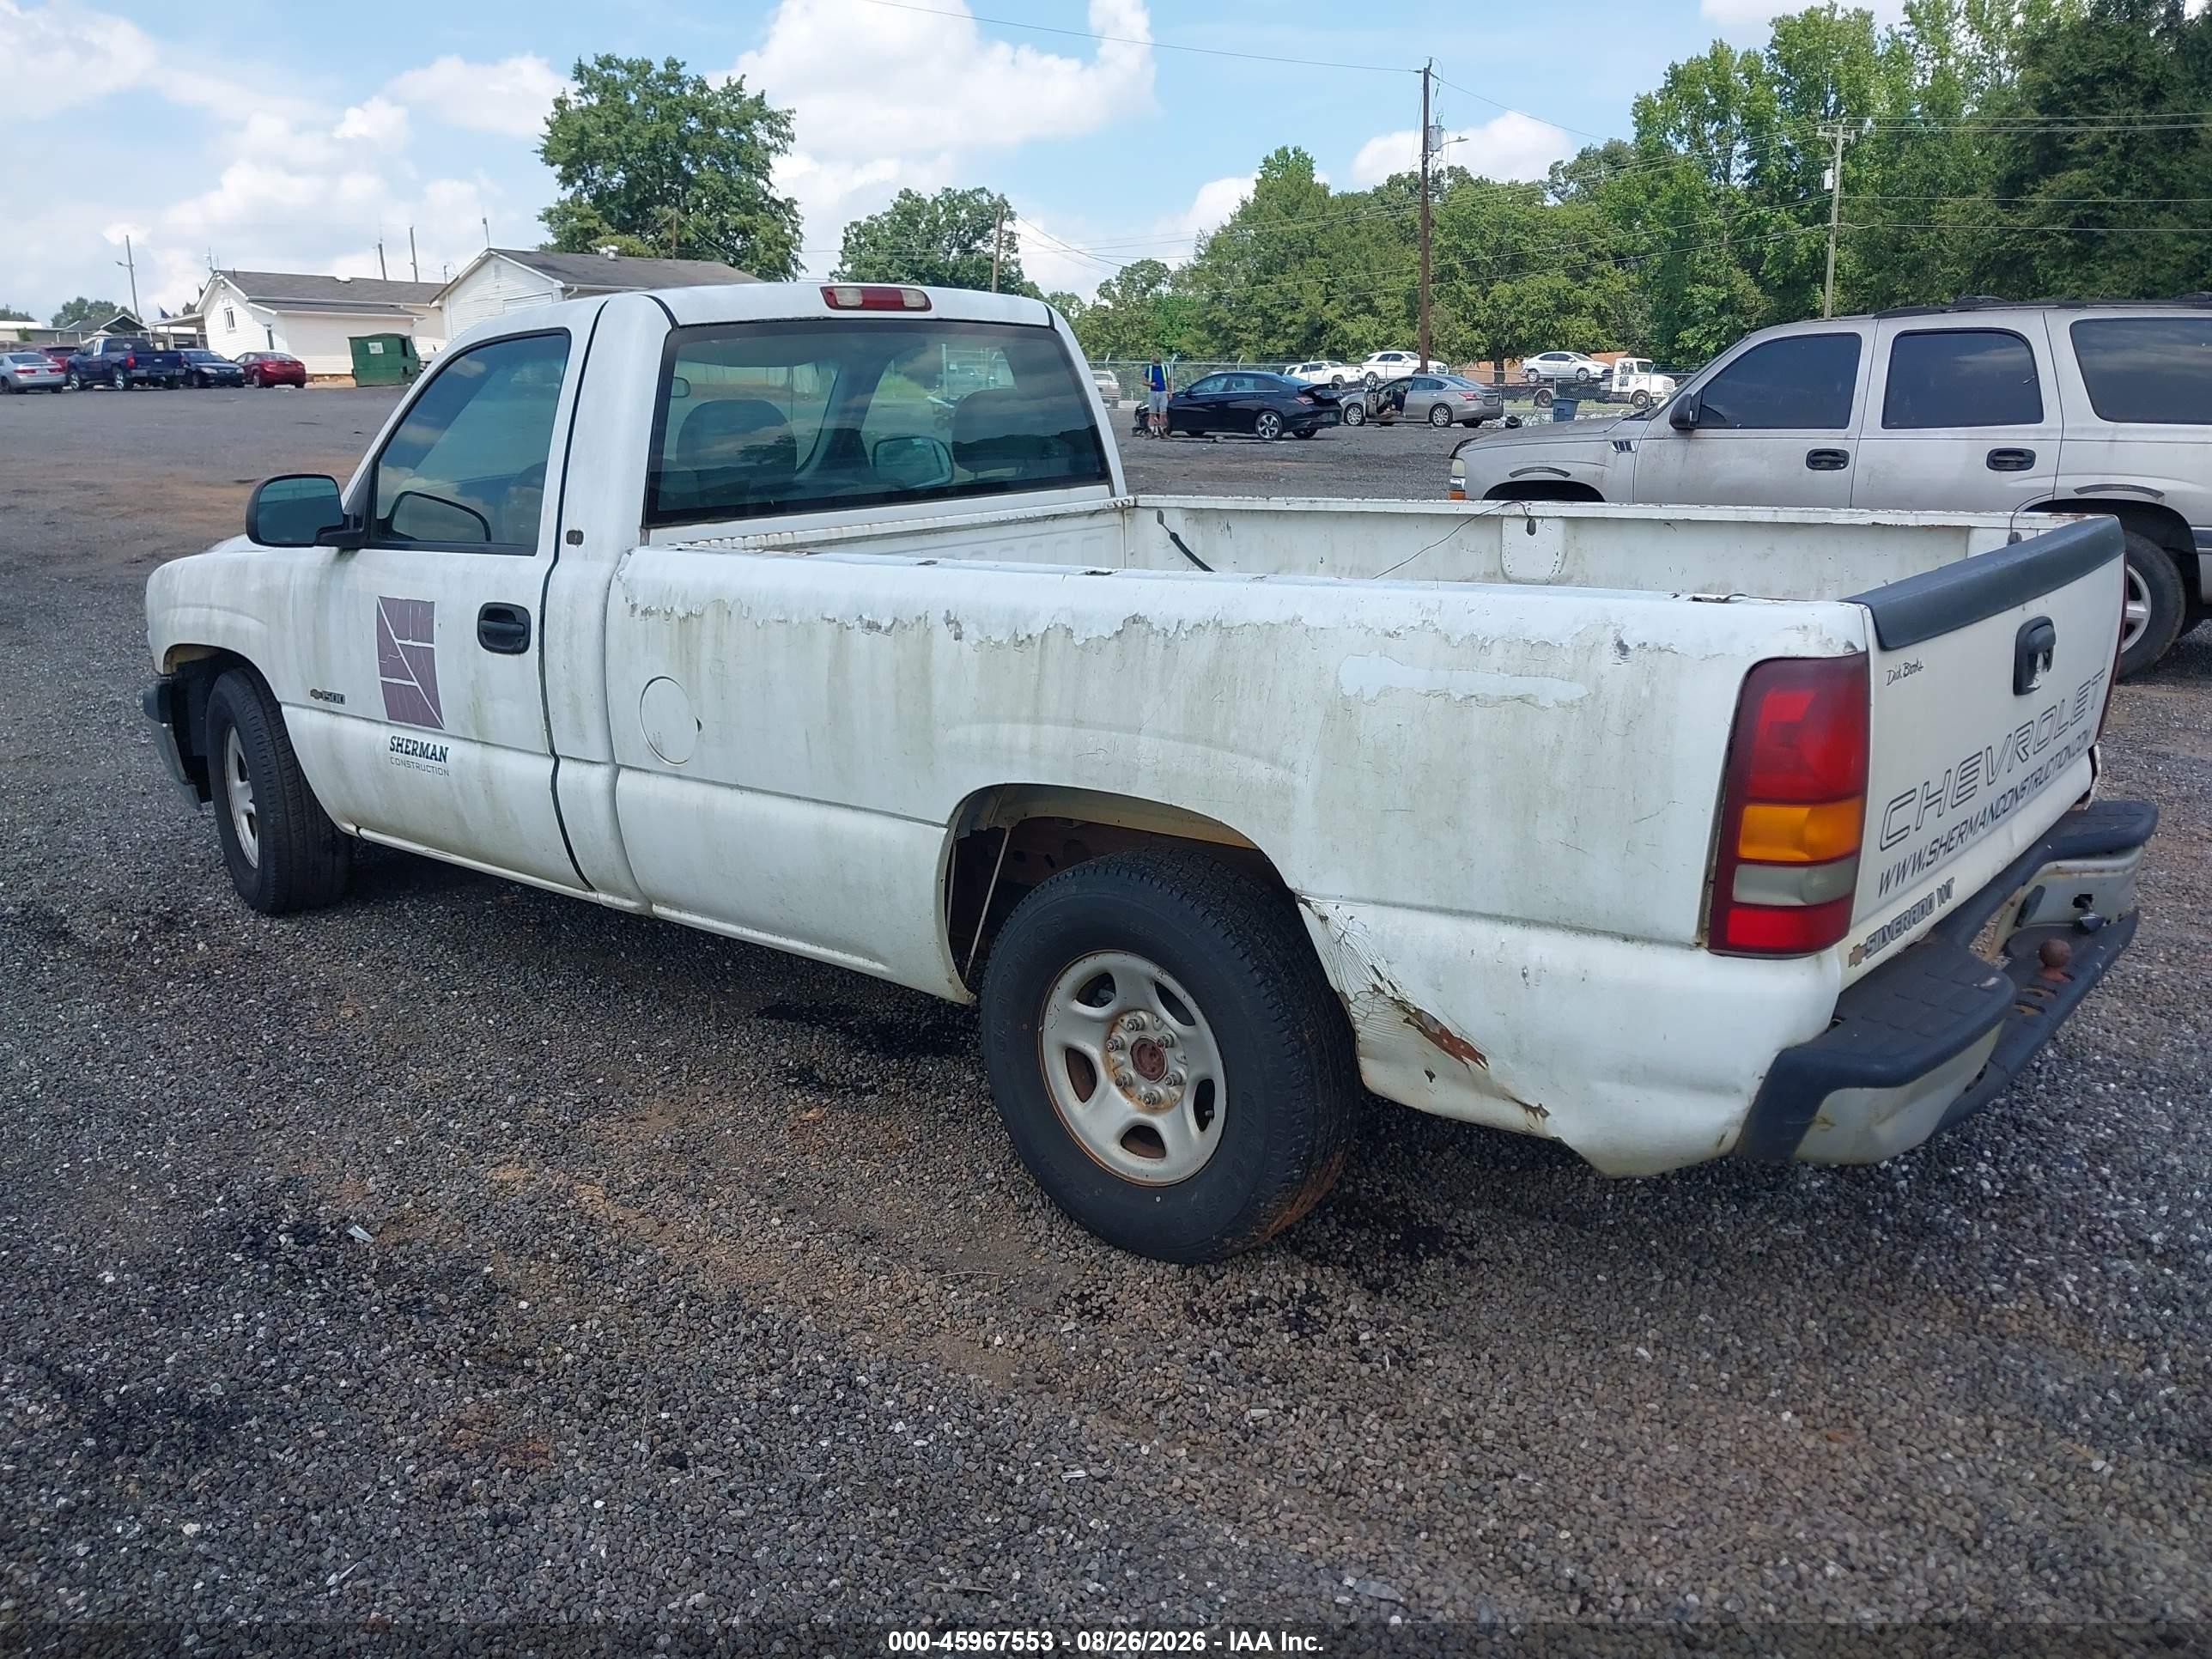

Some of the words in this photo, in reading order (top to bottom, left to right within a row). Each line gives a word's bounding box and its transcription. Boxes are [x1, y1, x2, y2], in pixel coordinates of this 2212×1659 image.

[322, 690, 346, 705] 1500
[389, 735, 449, 763] SHERMAN
[1880, 667, 2106, 852] CHEVROLET
[390, 757, 449, 777] CONSTRUCTION
[1865, 891, 1936, 960] SILVERADO
[1936, 877, 1955, 908] WT
